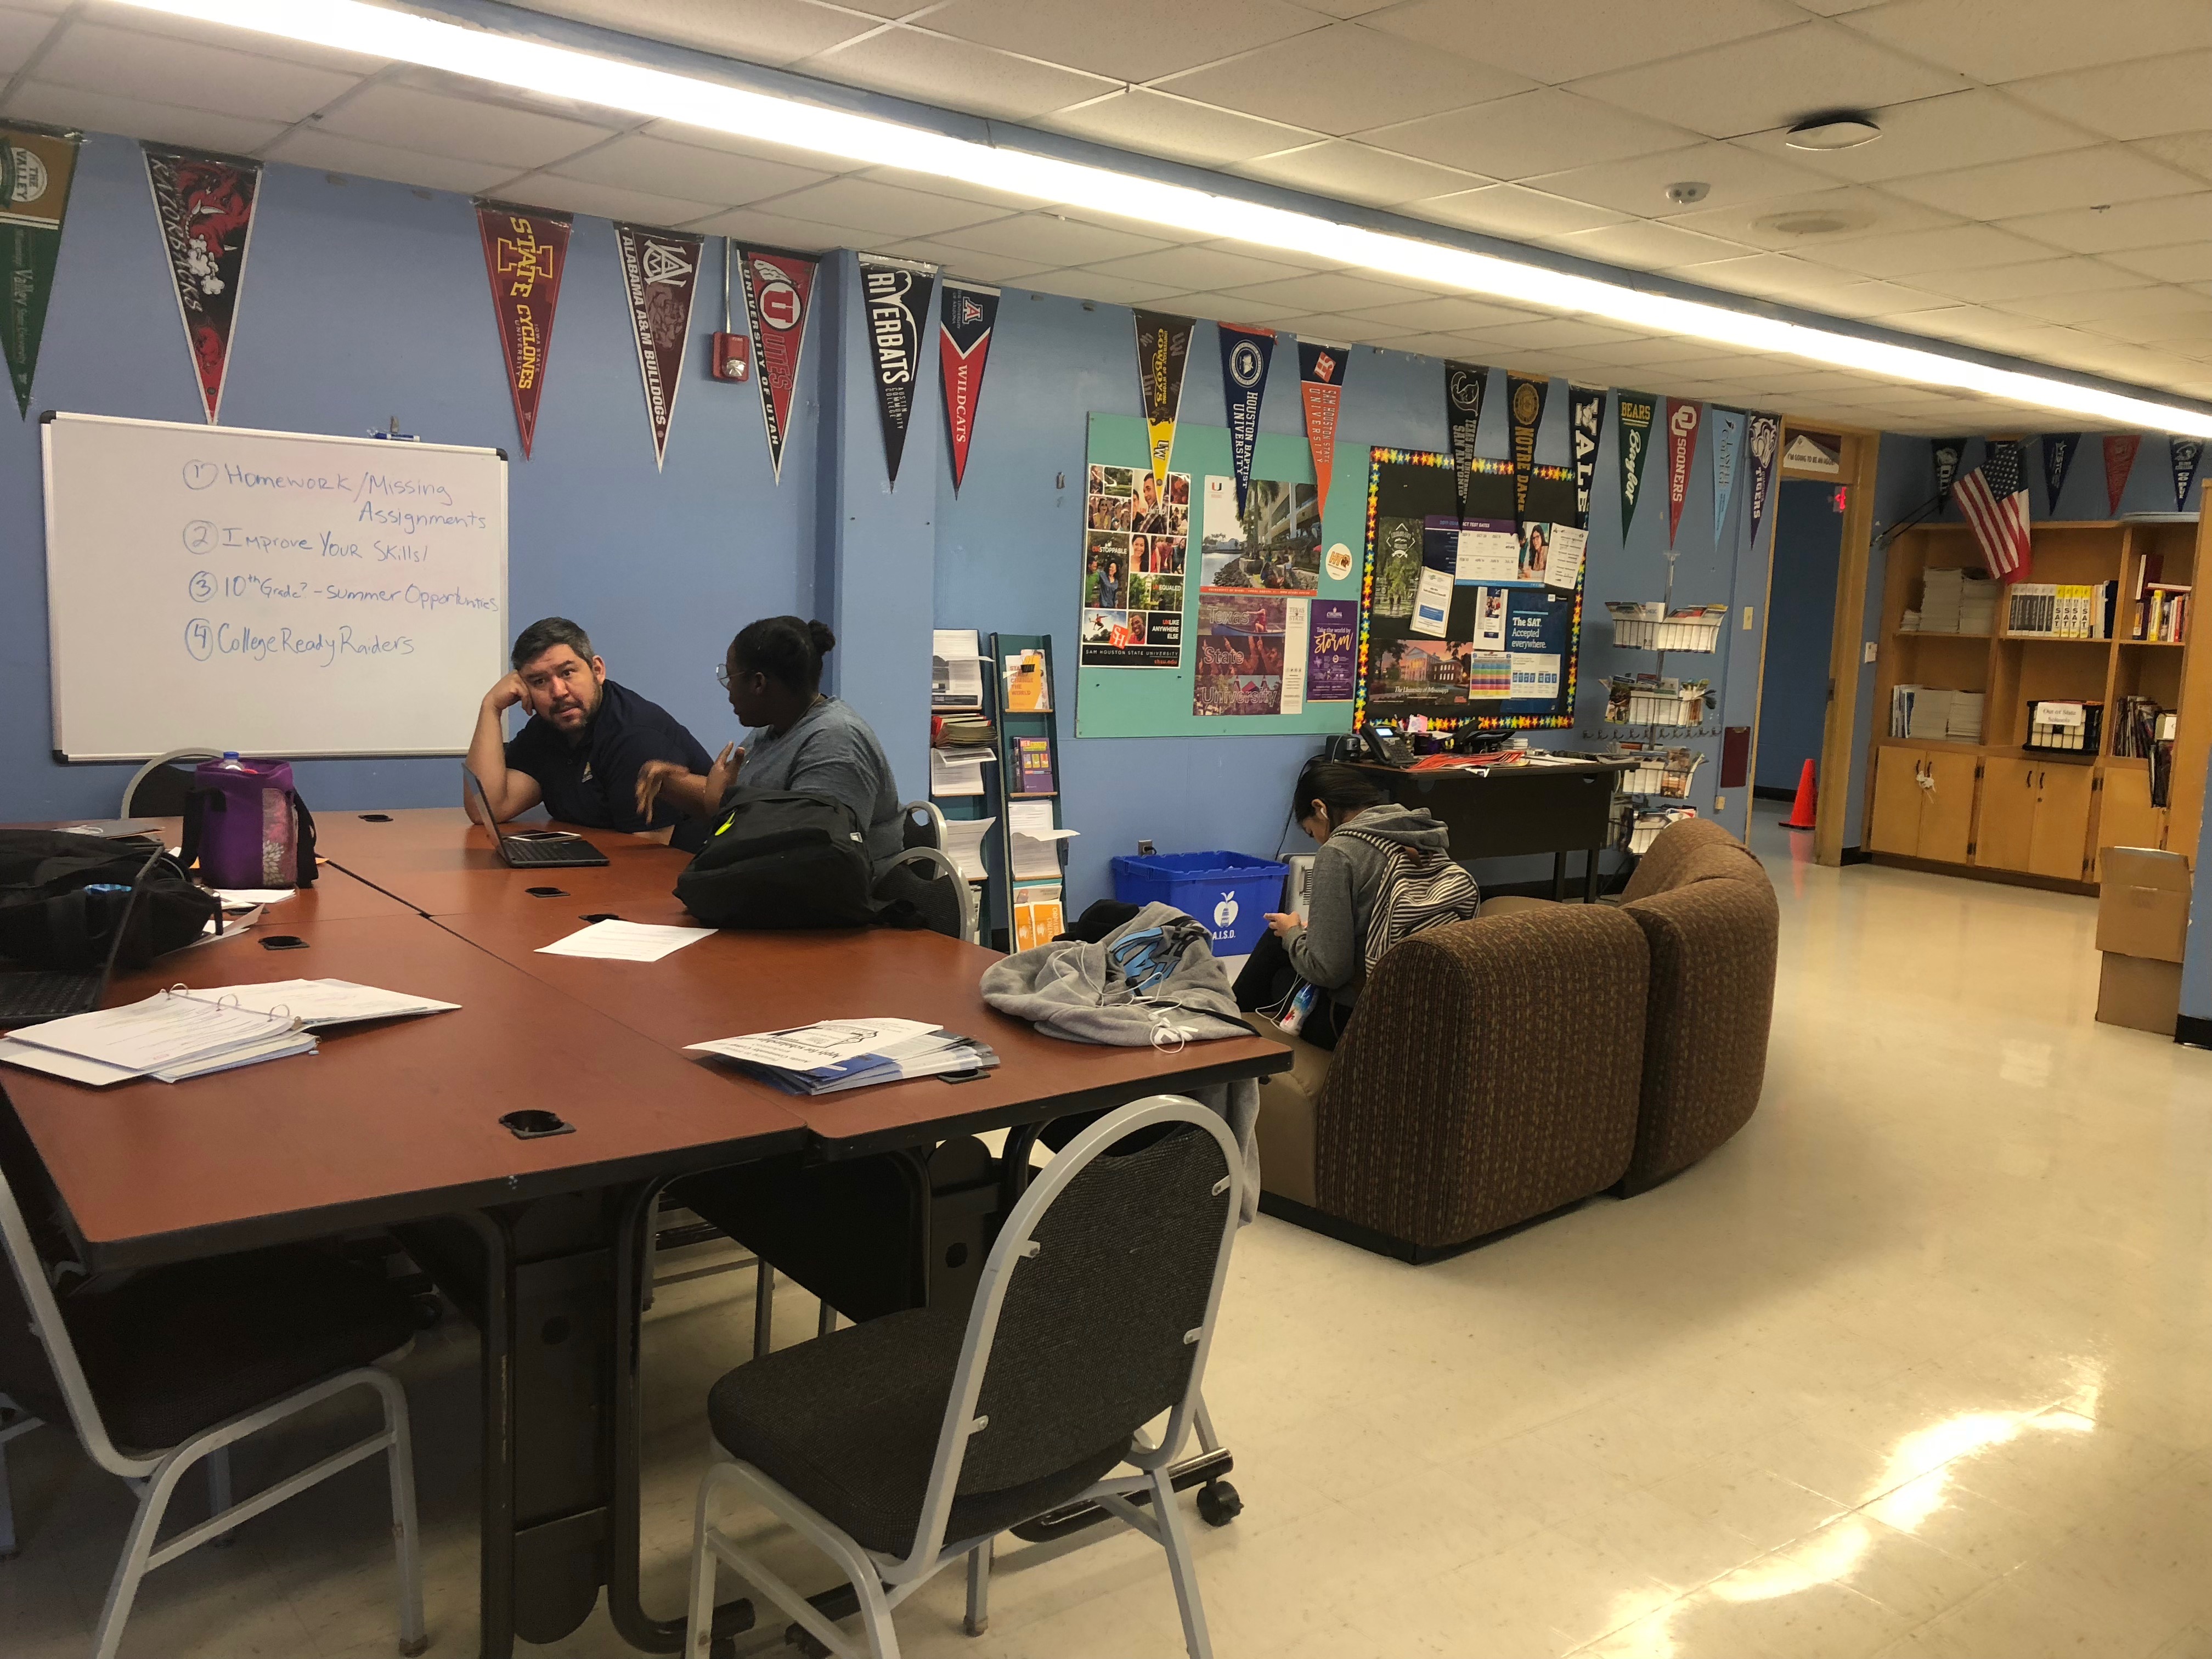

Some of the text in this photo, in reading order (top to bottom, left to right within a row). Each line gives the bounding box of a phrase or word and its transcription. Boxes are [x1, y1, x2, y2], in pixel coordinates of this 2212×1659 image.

[16, 151, 27, 200] VALLEY
[29, 167, 38, 188] THE
[14, 269, 35, 306] Valley
[510, 217, 537, 389] STATE CYCLONES
[764, 290, 793, 323] U
[962, 296, 983, 324] A
[622, 235, 666, 425] ALABAMA A&M BULLDOGS
[867, 270, 917, 384] RIVERBATS
[515, 319, 523, 376] UNIVERSITY
[744, 269, 779, 445] UNIVERSITY OF UTAH
[761, 332, 793, 390] UTES
[1155, 328, 1164, 402] COWBOYS
[885, 388, 896, 417] COLLEGE
[891, 387, 904, 430] COMMUNITY
[898, 386, 907, 412] AUSTIN
[956, 364, 968, 442] WILDCATS
[1323, 390, 1336, 405] SAM
[1621, 402, 1651, 420] BEARS
[1309, 388, 1323, 463] UNIVERSITY
[1323, 407, 1335, 439] HOUSTON
[1464, 419, 1476, 442] TEXAS
[1671, 405, 1697, 437] OU
[1154, 439, 1169, 460] UW
[1233, 403, 1244, 475] UNIVERSITY
[1242, 391, 1258, 489] HOUSTON BAPTIST
[1515, 426, 1534, 471] NOTRE
[1575, 397, 1600, 512] YALE
[1453, 425, 1465, 496] SAN ANTONIO
[1625, 428, 1641, 505] Baylor
[1673, 438, 1687, 502] SOONERS
[1516, 475, 1529, 512] DAME
[358, 500, 486, 534] Assignments
[1207, 606, 1250, 625] Texas
[1513, 617, 1526, 626] The
[1113, 627, 1125, 647] SH
[1314, 631, 1353, 653] storm
[1512, 628, 1539, 639] Accepted
[1512, 639, 1547, 649] everywhere.
[1204, 646, 1244, 664] State
[1200, 686, 1277, 707] University
[1212, 929, 1236, 940] A.I.S.D.
[818, 1050, 843, 1058] Apply
